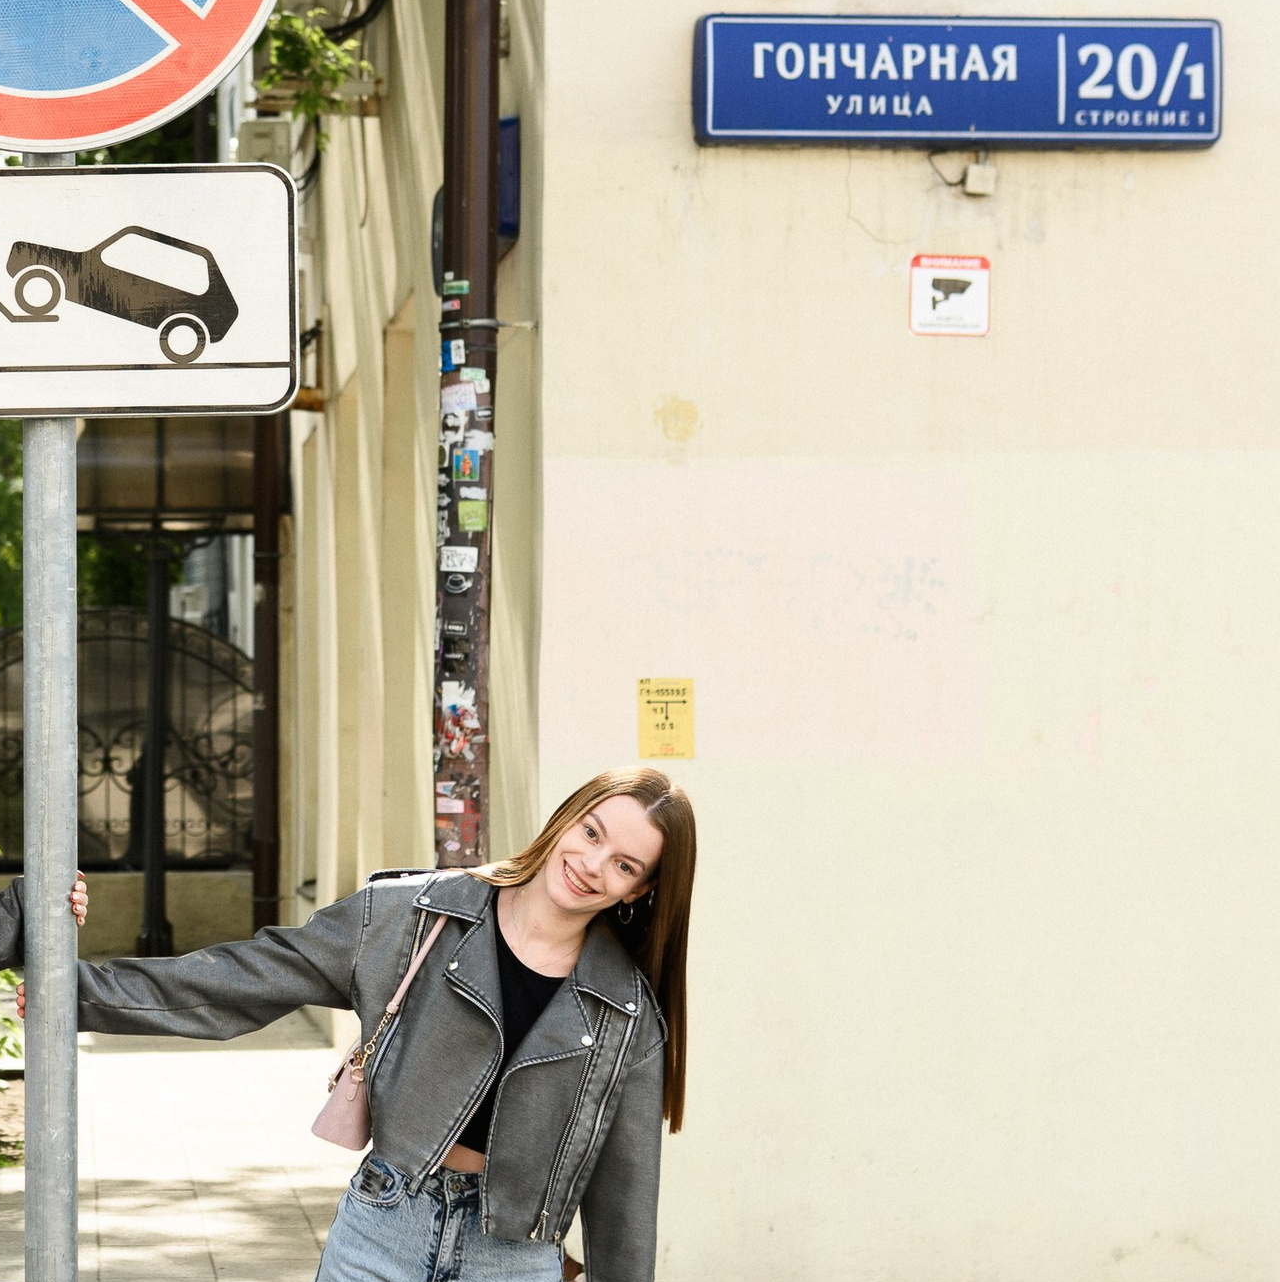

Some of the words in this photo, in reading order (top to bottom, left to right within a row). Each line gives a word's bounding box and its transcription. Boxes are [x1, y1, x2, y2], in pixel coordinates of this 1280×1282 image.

[753, 42, 1018, 81] ГОНЧАРНАЯ
[1077, 41, 1206, 107] 20/1
[826, 94, 933, 118] УЛИЦА
[1074, 109, 1191, 127] СТРОЕНИЕ
